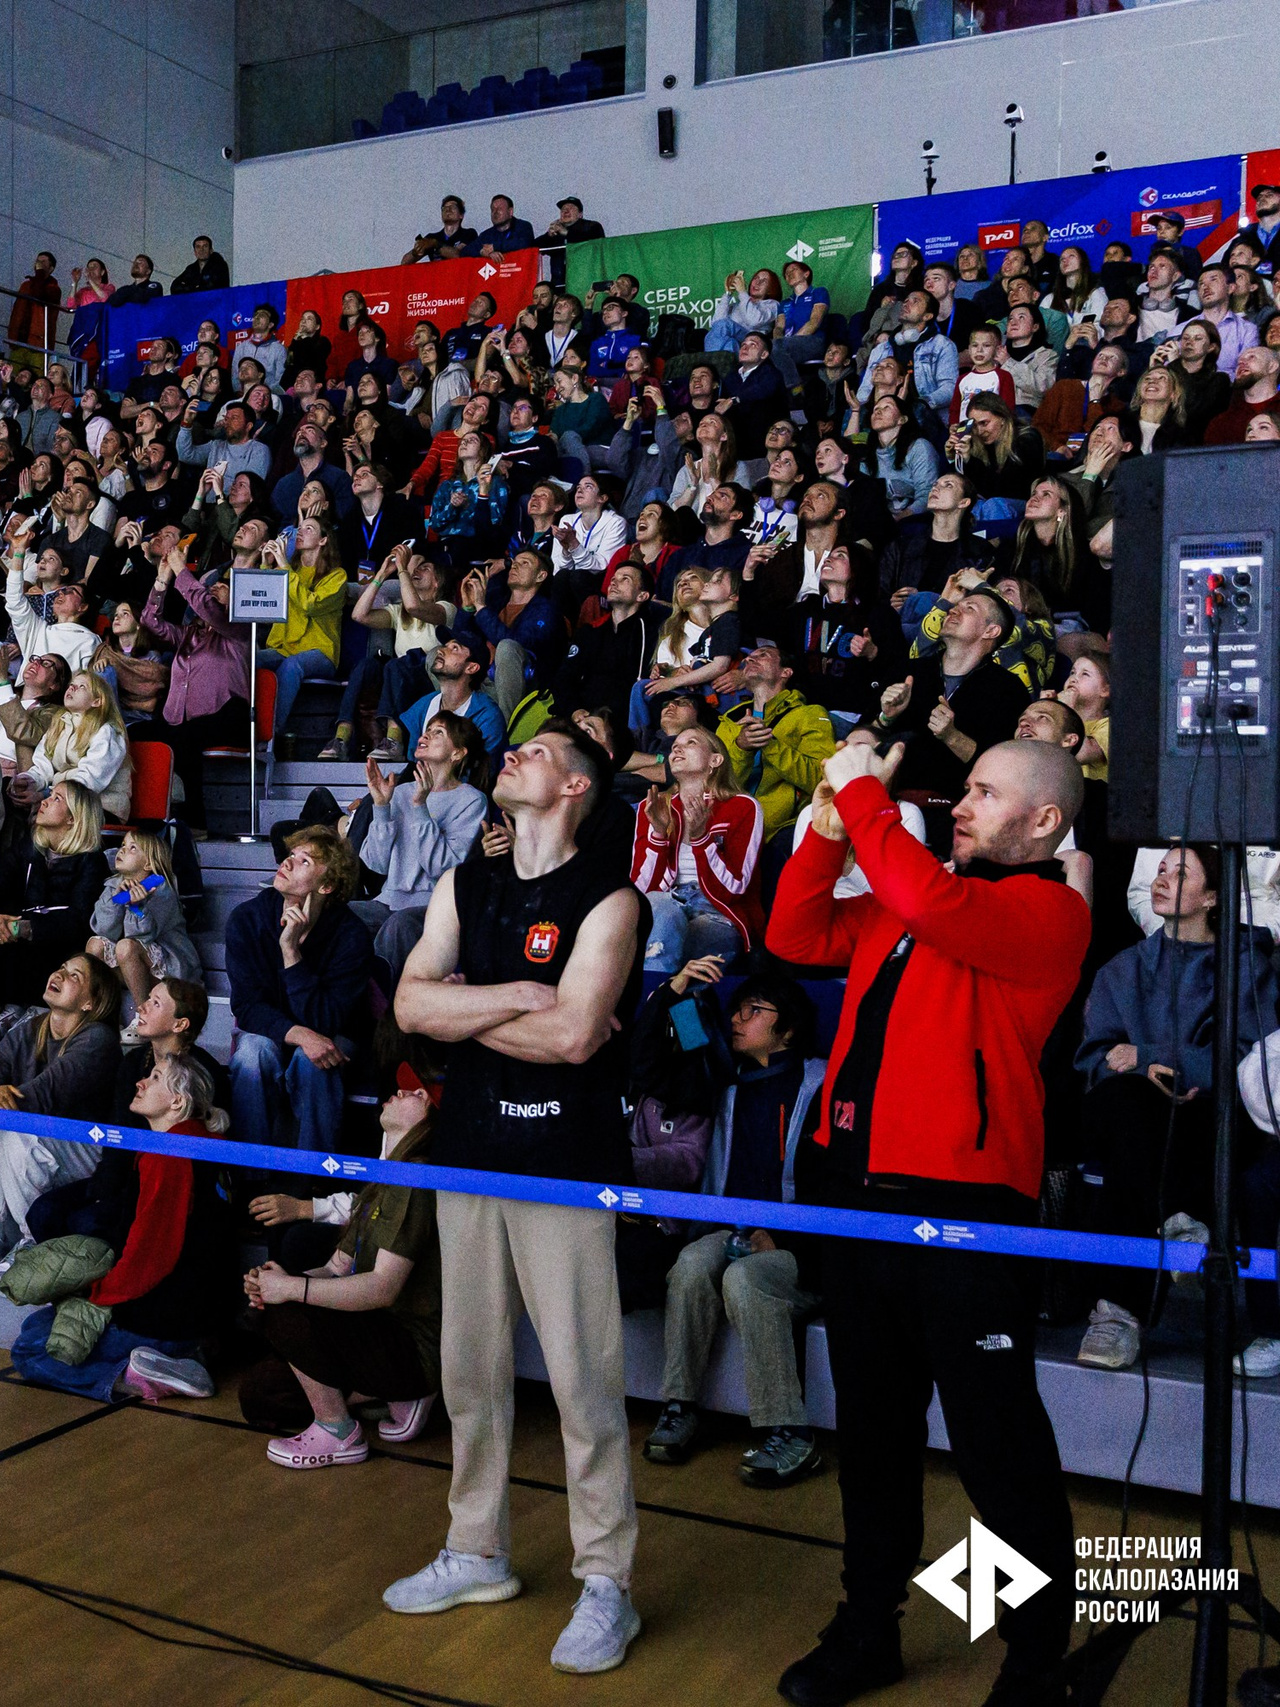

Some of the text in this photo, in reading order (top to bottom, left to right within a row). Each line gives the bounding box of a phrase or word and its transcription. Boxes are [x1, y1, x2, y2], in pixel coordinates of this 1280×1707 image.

[407, 292, 429, 302] СБЕР
[644, 286, 691, 304] СБЕР
[406, 297, 466, 310] СТРАХОВАНИЕ
[406, 308, 437, 317] ЖИЗНИ
[260, 600, 278, 608] ГОСТЕЙ
[500, 1100, 561, 1118] TENGU'S
[292, 1453, 335, 1465] crocs
